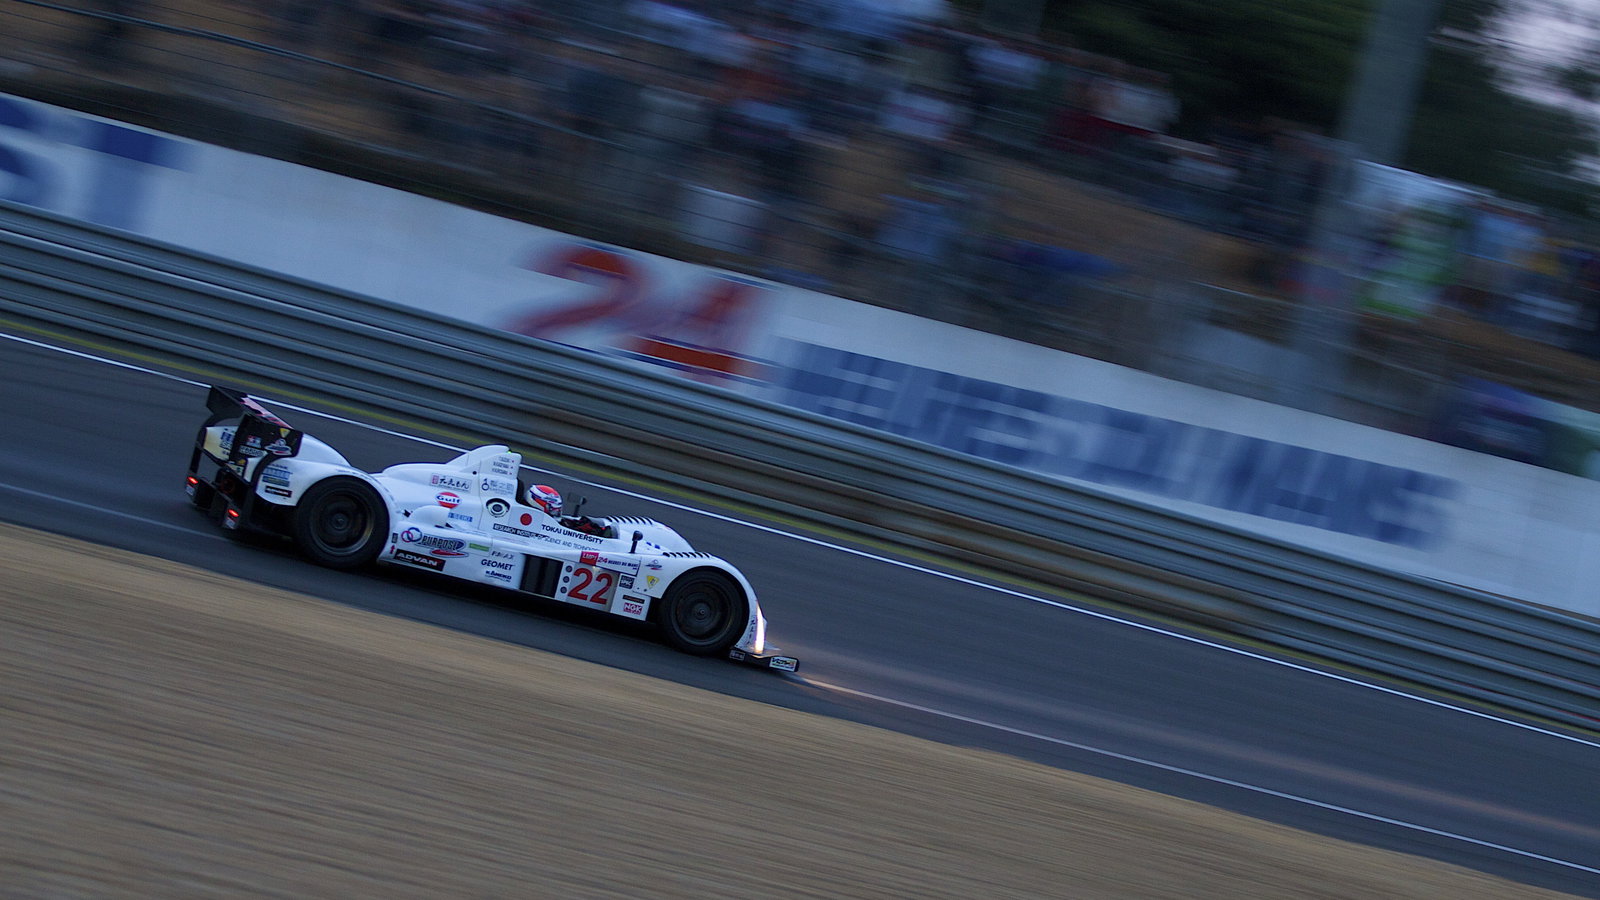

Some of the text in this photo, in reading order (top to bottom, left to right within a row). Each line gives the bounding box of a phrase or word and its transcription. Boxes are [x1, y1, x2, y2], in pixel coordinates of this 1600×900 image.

[436, 495, 460, 504] Gulf
[541, 524, 604, 545] TOKAI UNIVERSITY
[396, 552, 438, 566] ADVAN
[481, 559, 515, 571] GEOMET
[597, 556, 608, 564] 24
[567, 567, 613, 605] 22
[624, 602, 642, 612] NGK
